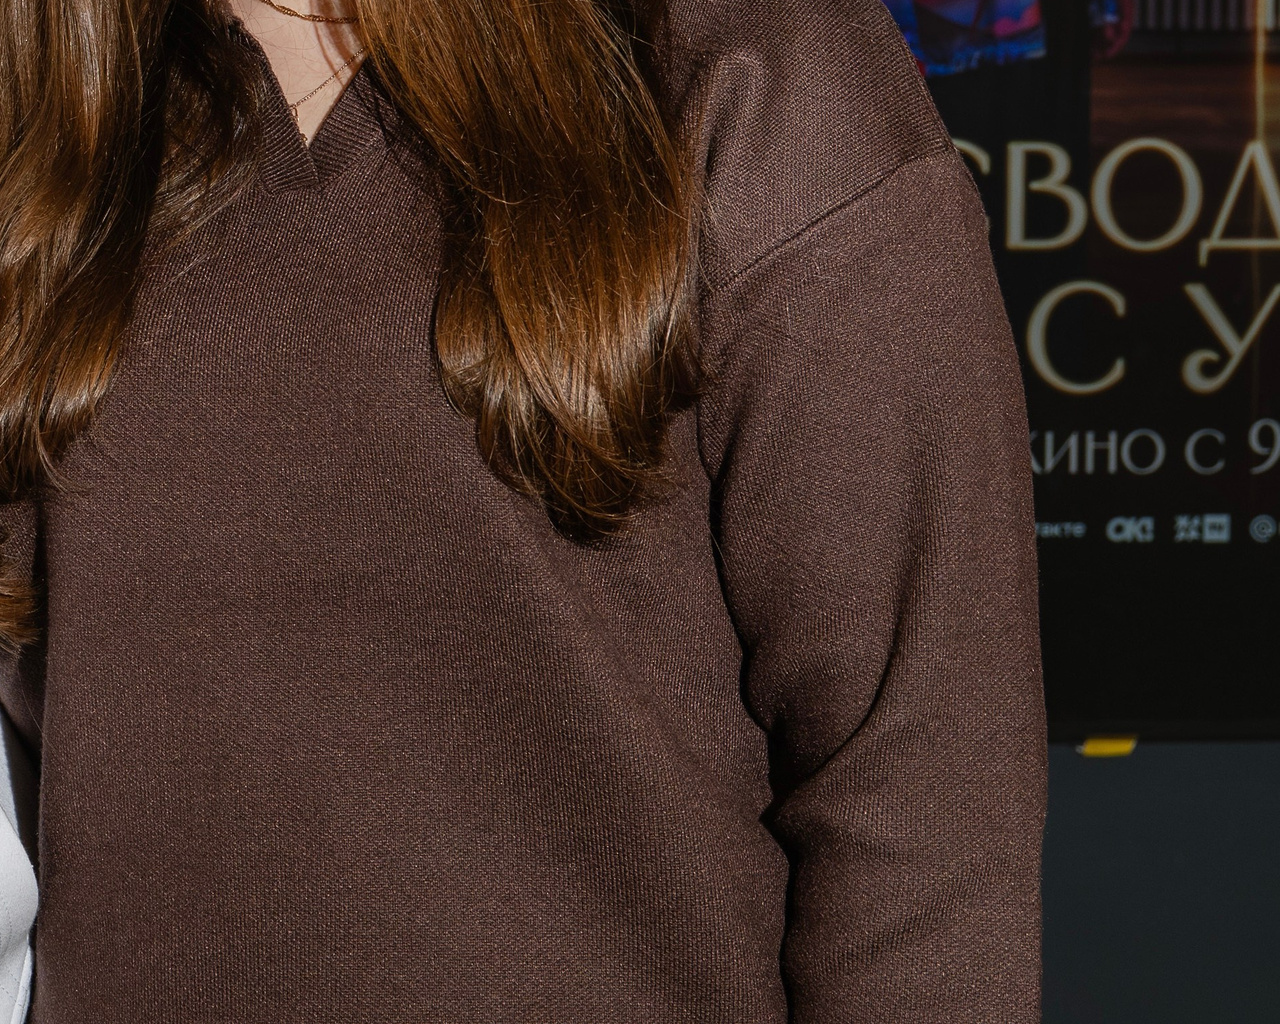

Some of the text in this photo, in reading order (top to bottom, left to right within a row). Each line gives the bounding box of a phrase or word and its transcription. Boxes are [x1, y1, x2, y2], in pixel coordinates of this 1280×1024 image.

[953, 137, 1280, 267] ВОД
[1026, 280, 1126, 394] С
[1184, 428, 1225, 474] С
[1248, 418, 1280, 474] 9
